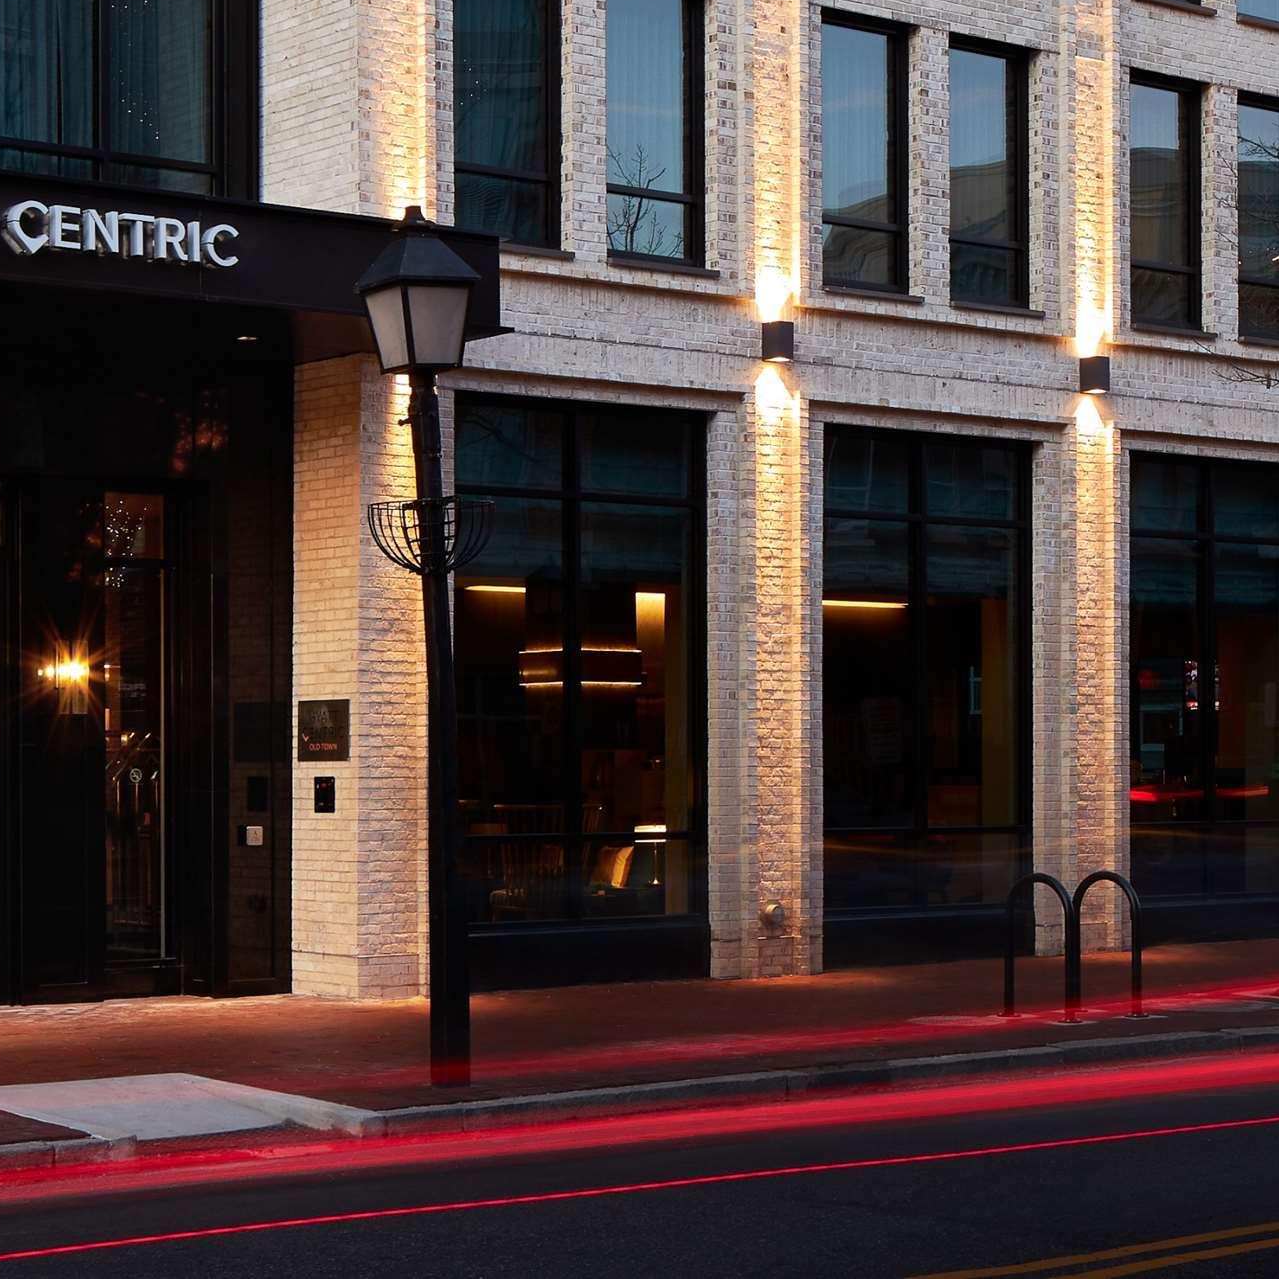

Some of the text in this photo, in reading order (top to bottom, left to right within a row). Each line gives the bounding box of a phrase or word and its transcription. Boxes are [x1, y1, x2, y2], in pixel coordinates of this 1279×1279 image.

[3, 200, 239, 267] CENTRIC
[309, 743, 337, 751] OLD TOWN
